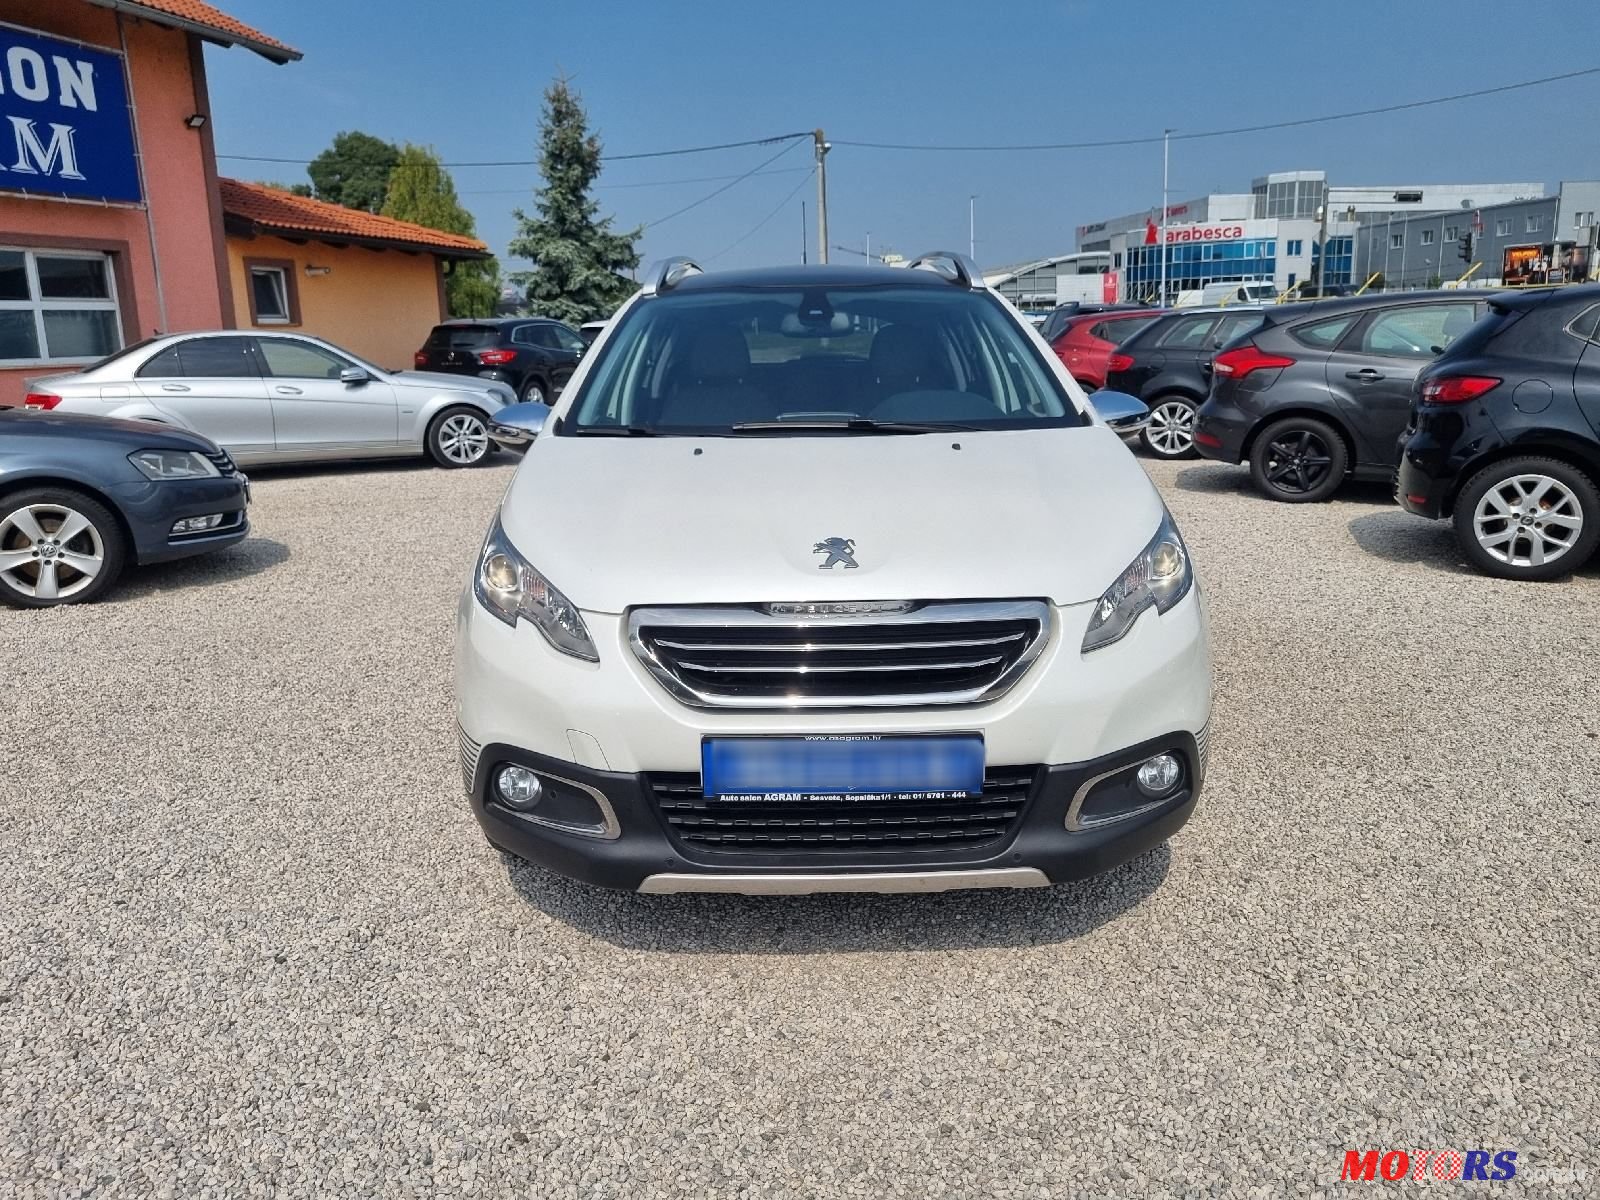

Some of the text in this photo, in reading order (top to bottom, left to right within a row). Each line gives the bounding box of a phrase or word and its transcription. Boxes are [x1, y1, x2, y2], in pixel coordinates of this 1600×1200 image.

[0, 46, 97, 112] ON
[0, 115, 87, 181] M
[1166, 226, 1243, 242] arabesca
[795, 602, 884, 612] PEUGEOT
[763, 793, 801, 801] AGRAM
